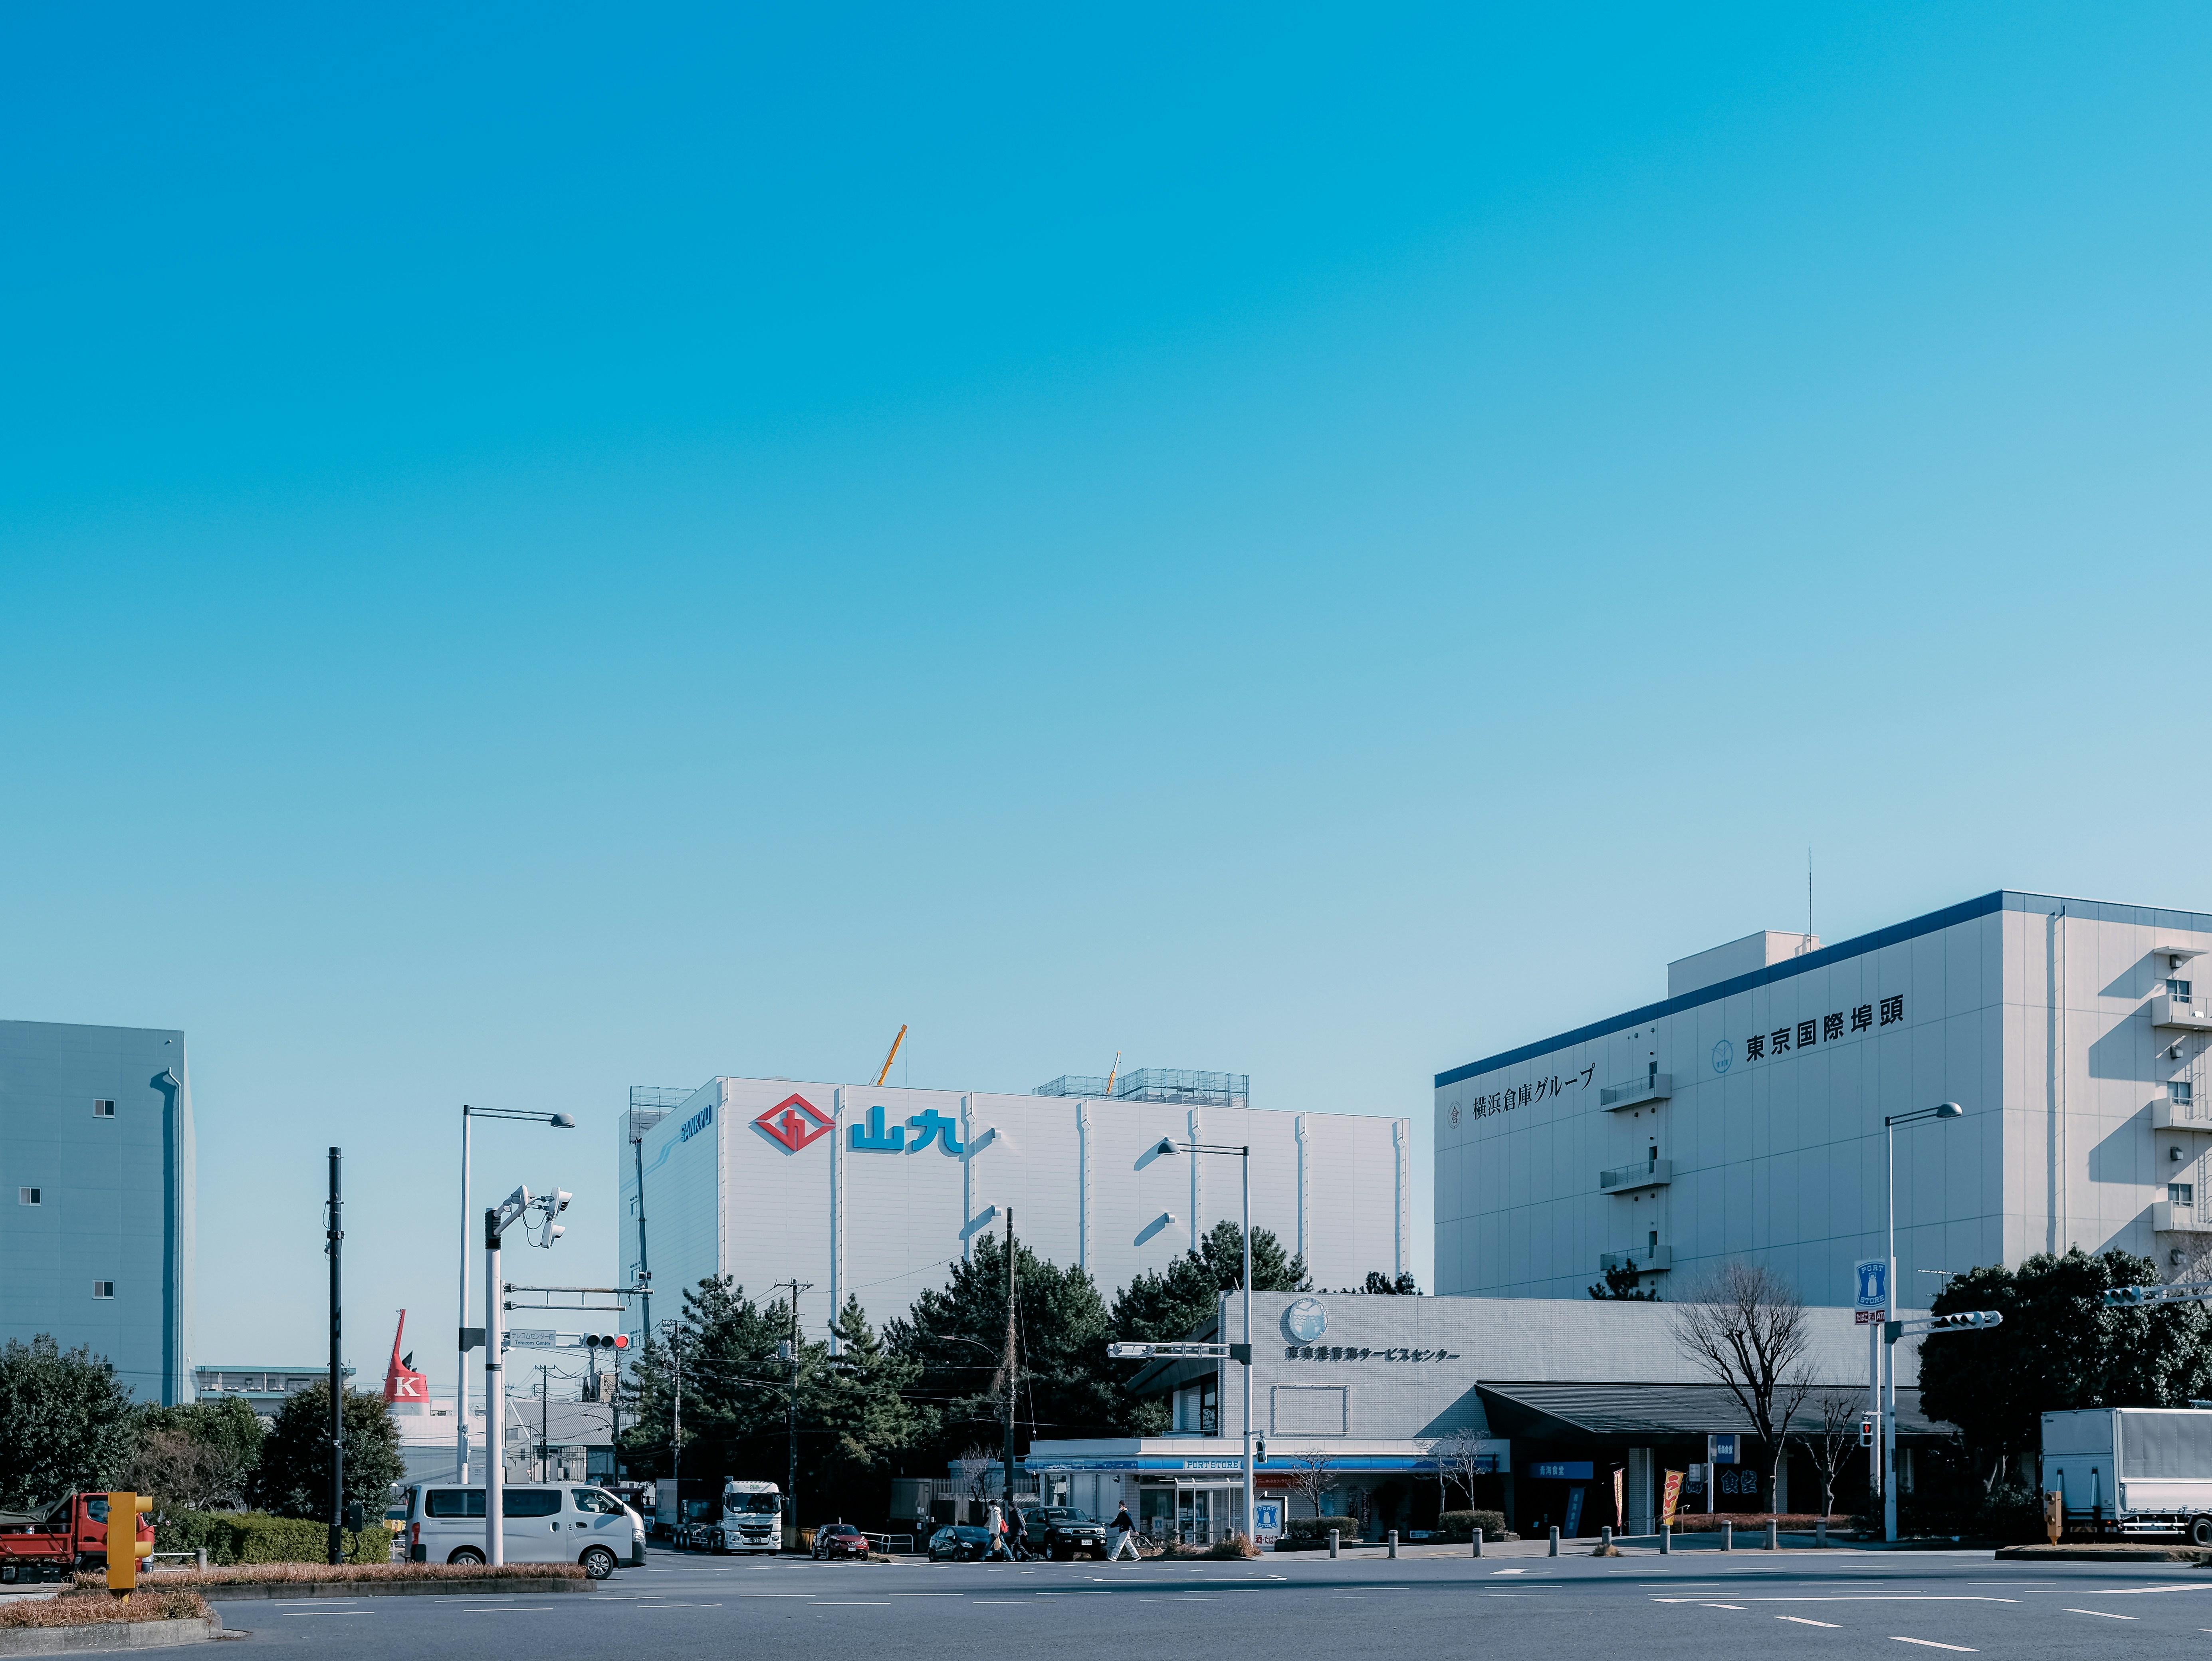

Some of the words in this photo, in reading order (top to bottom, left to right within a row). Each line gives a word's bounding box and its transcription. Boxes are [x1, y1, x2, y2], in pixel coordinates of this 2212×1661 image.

[1746, 994, 1904, 1062] 東京国際埠頭
[1473, 1062, 1596, 1120] 横浜倉庫グループ
[680, 1104, 712, 1142] SANKYU
[853, 1106, 964, 1153] 山九
[1861, 1265, 1883, 1274] PORT
[1860, 1295, 1885, 1304] STORE
[1286, 1346, 1461, 1362] 東京港青海サービスセンター
[394, 1377, 420, 1396] K
[1540, 1466, 1564, 1475] 青海食堂
